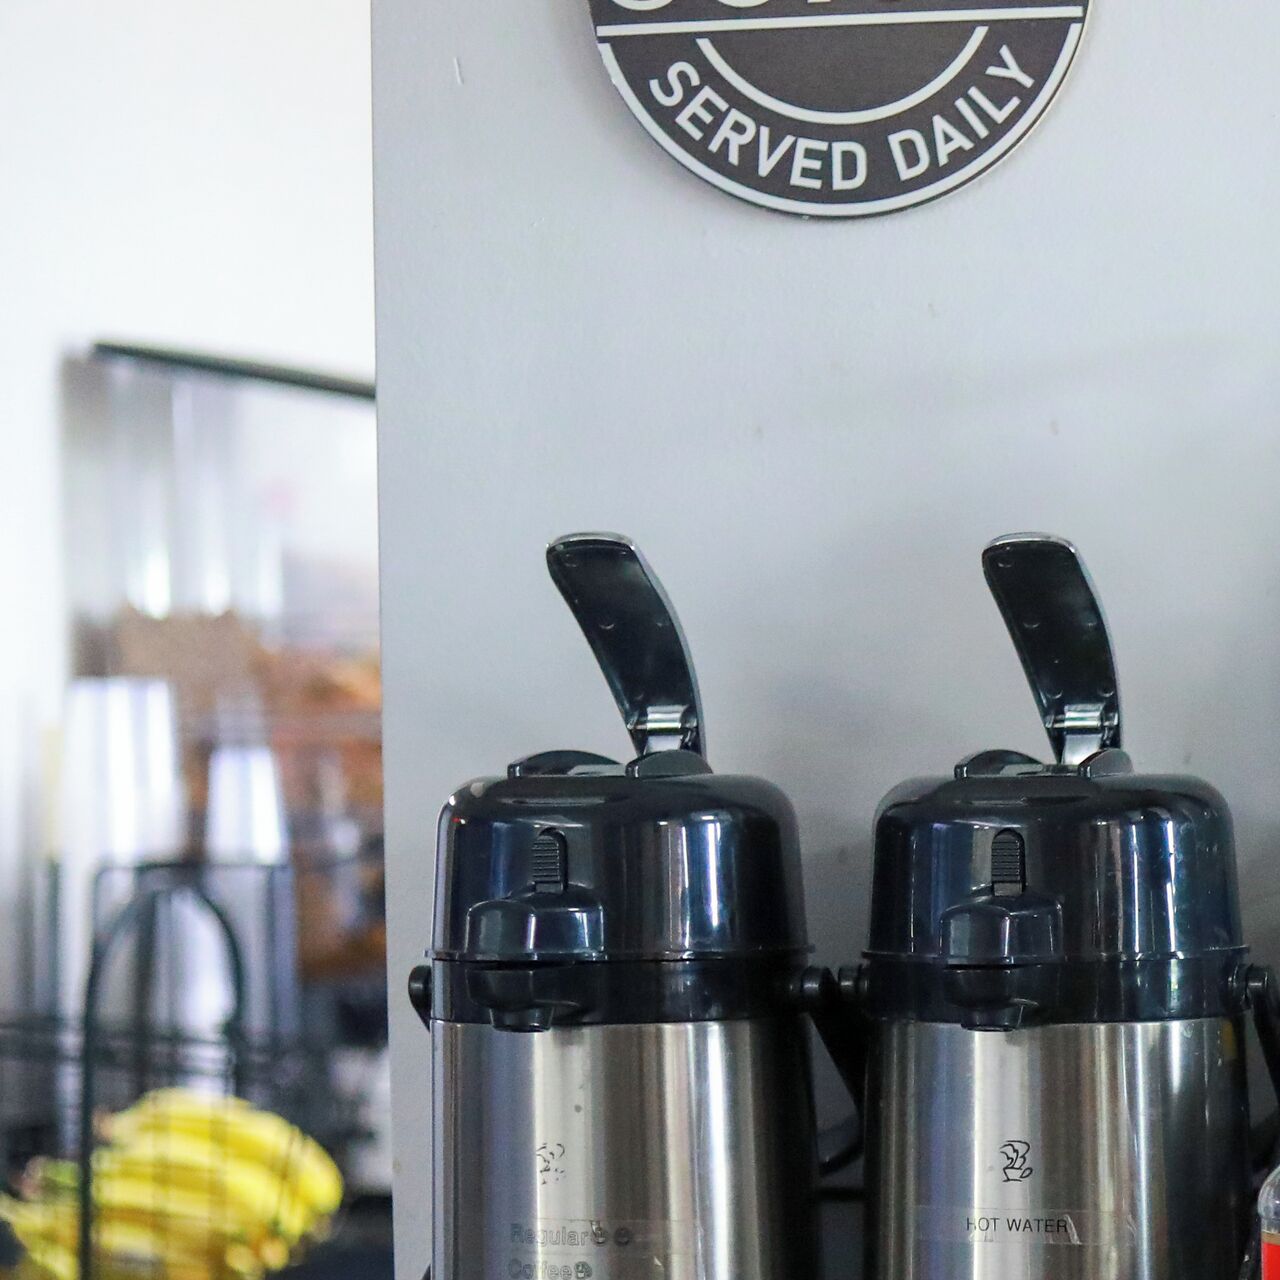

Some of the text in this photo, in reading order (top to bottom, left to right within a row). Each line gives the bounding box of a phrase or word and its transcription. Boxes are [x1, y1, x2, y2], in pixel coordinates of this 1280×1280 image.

[649, 44, 1035, 191] SERVED DAILY
[509, 1222, 591, 1248] Regular
[966, 1217, 1069, 1233] HOT WATER
